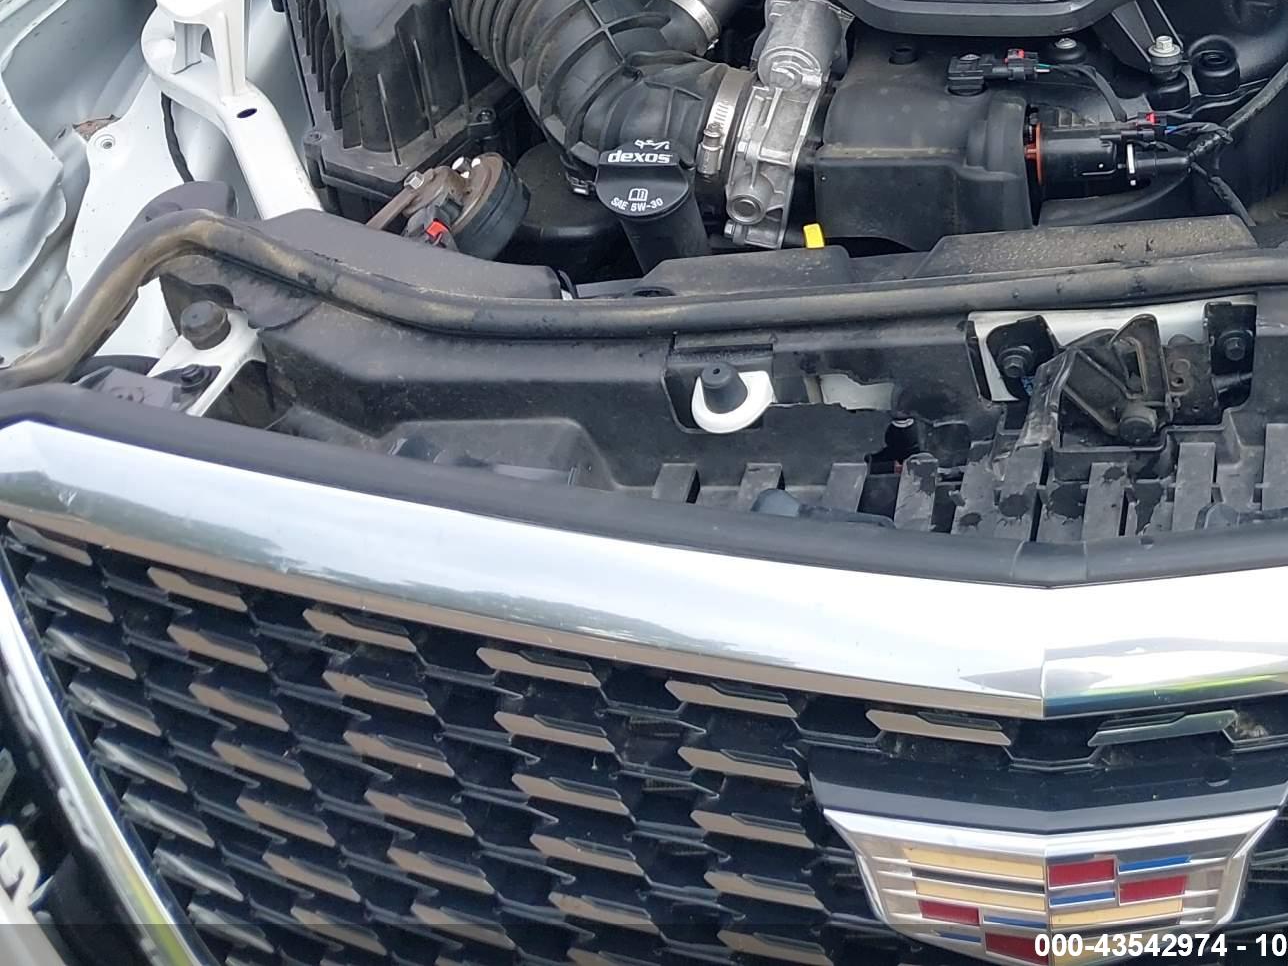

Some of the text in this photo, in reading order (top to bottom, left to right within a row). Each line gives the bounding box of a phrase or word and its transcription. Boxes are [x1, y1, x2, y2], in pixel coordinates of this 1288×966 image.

[607, 150, 673, 164] dexos
[610, 197, 664, 212] SAE 5W-30
